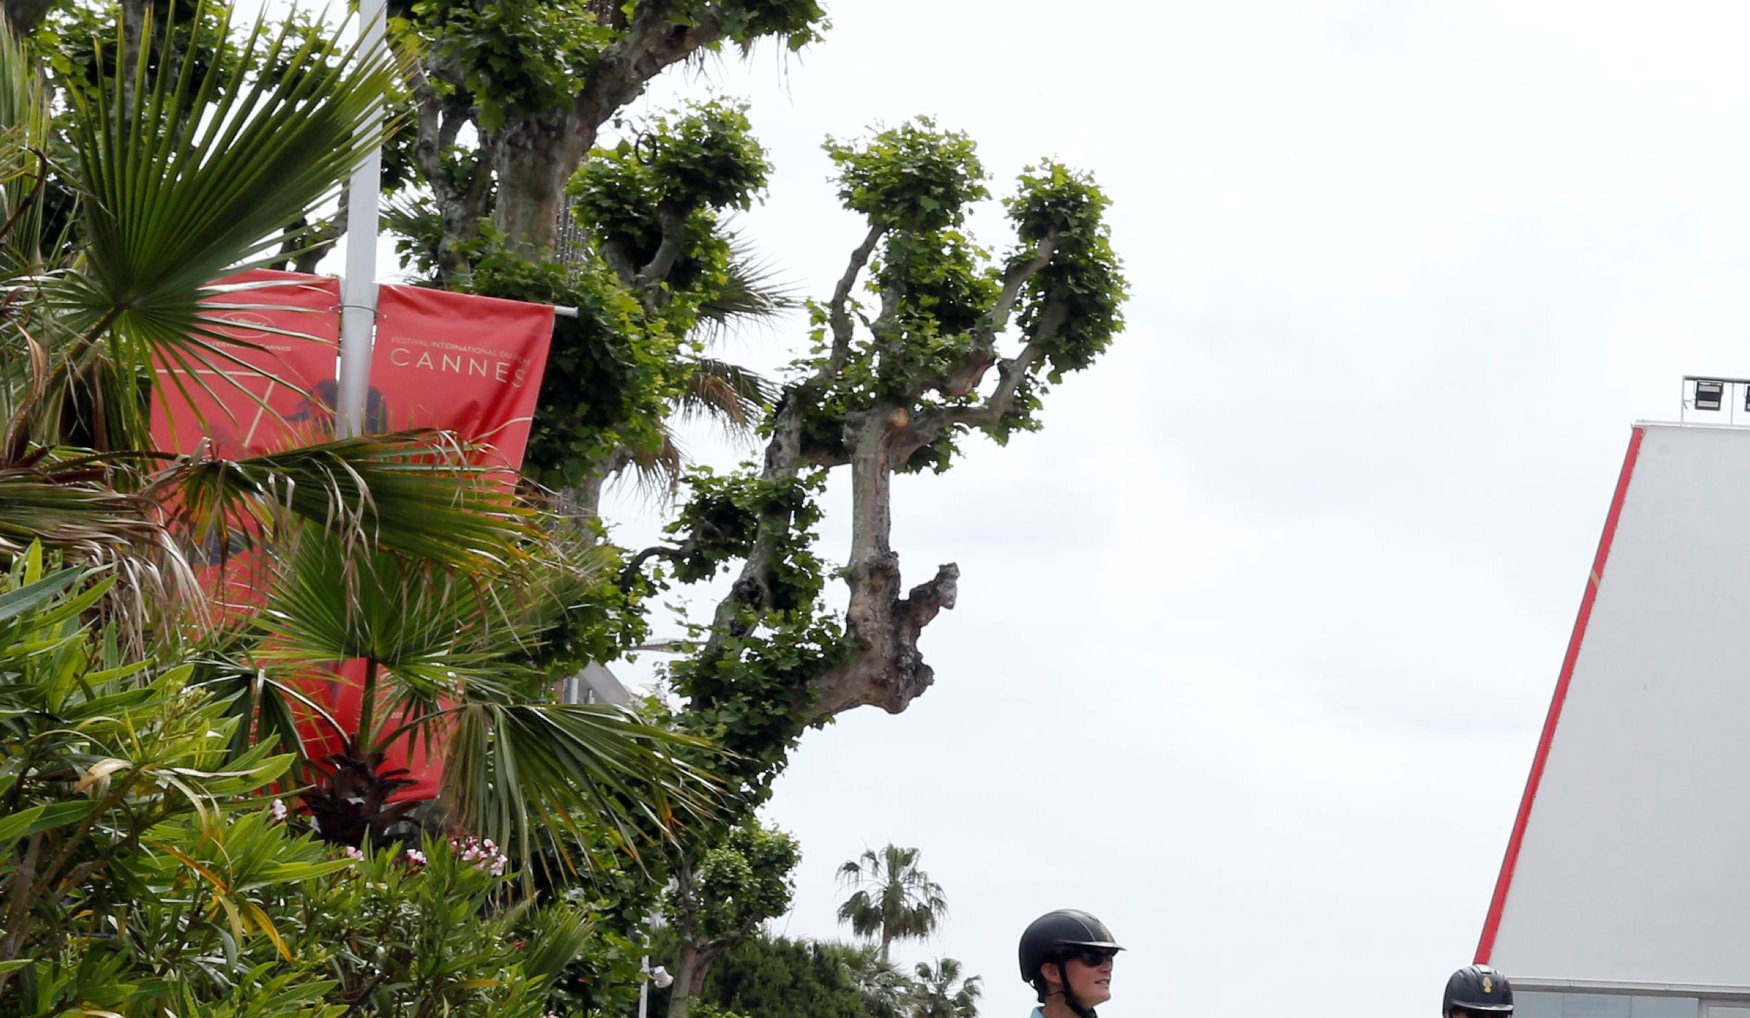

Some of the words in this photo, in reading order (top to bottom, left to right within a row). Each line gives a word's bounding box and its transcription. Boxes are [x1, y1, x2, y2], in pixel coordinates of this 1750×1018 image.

[391, 336, 428, 347] FESTIVAL
[431, 342, 496, 356] INTERNATIONAL
[390, 347, 527, 388] CANNES
